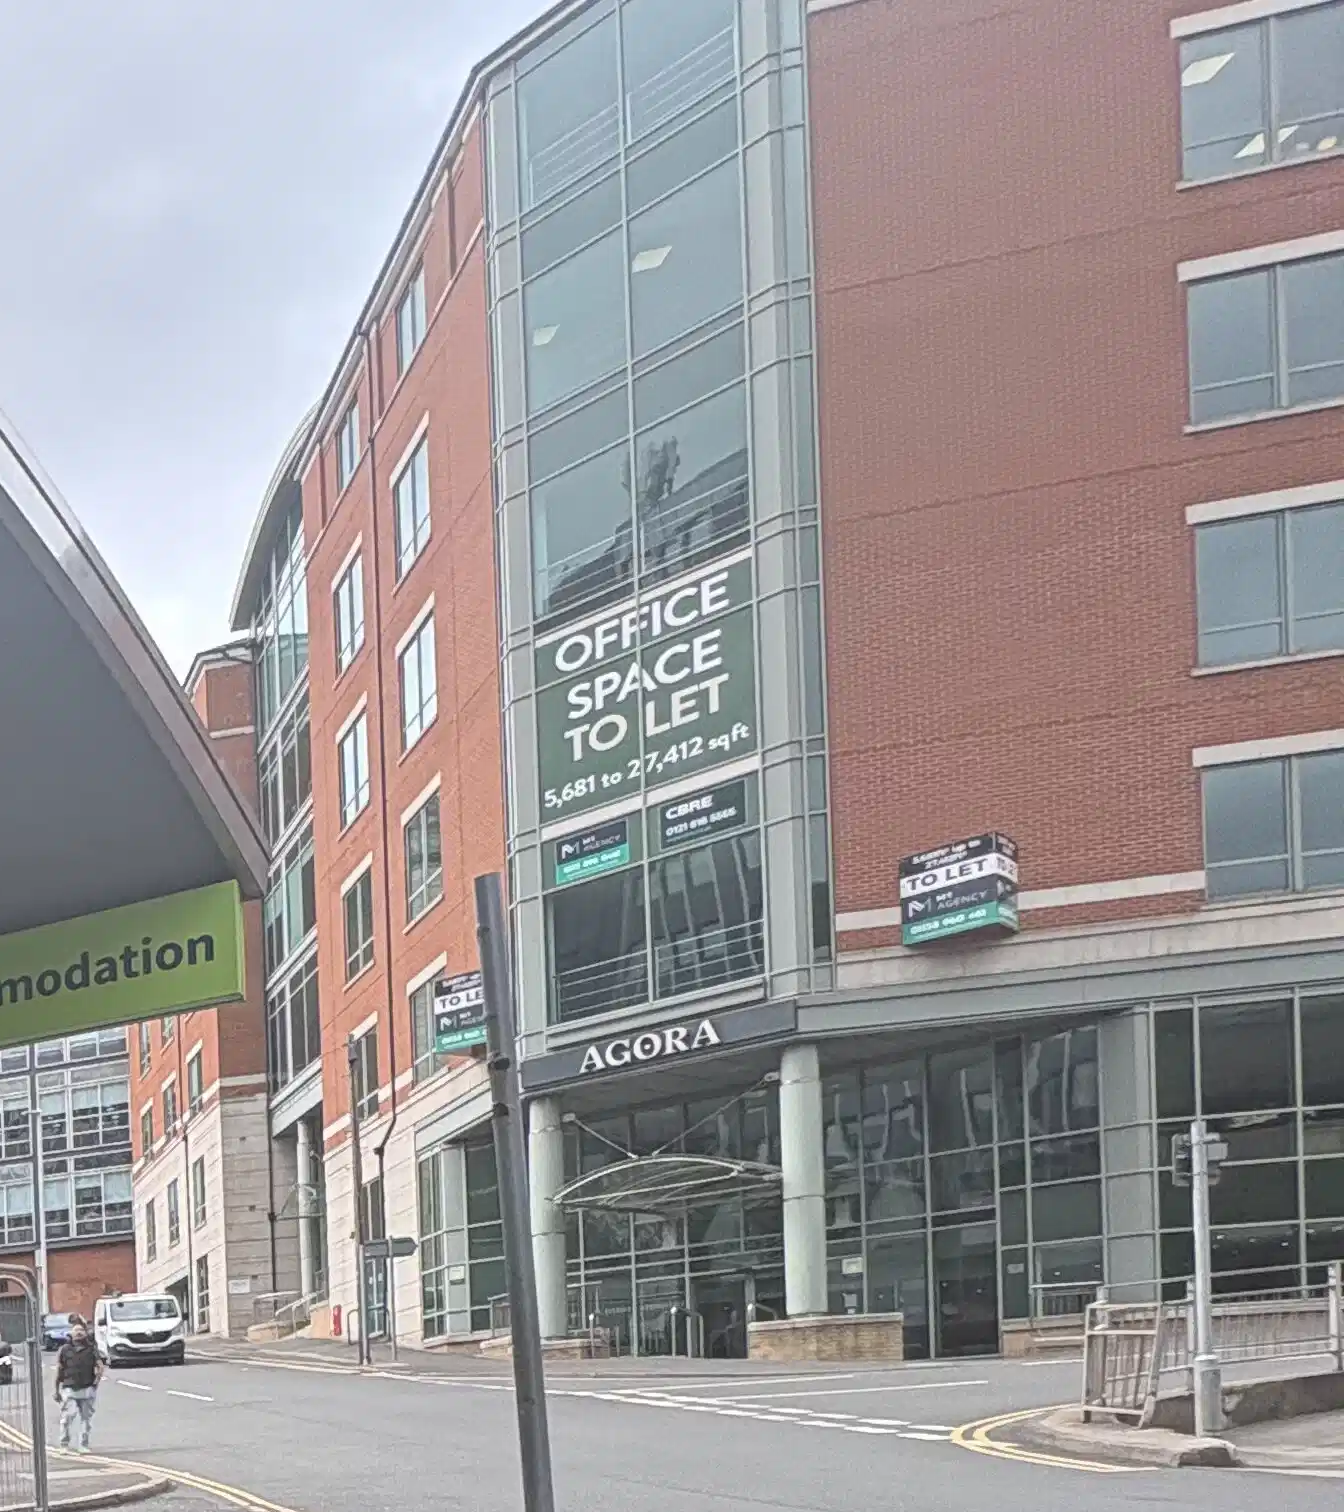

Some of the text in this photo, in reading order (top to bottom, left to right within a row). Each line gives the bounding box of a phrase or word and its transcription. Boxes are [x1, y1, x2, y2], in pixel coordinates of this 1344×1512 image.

[555, 571, 729, 671] OFFICE
[567, 629, 722, 719] SPACE
[564, 673, 729, 762] TO LET
[544, 722, 750, 808] 5,681 to 27,412 sq ft
[665, 795, 714, 819] CBRE
[906, 873, 938, 890] TO
[945, 859, 989, 880] LET
[439, 996, 460, 1009] TO
[579, 1019, 721, 1074] AGORA
